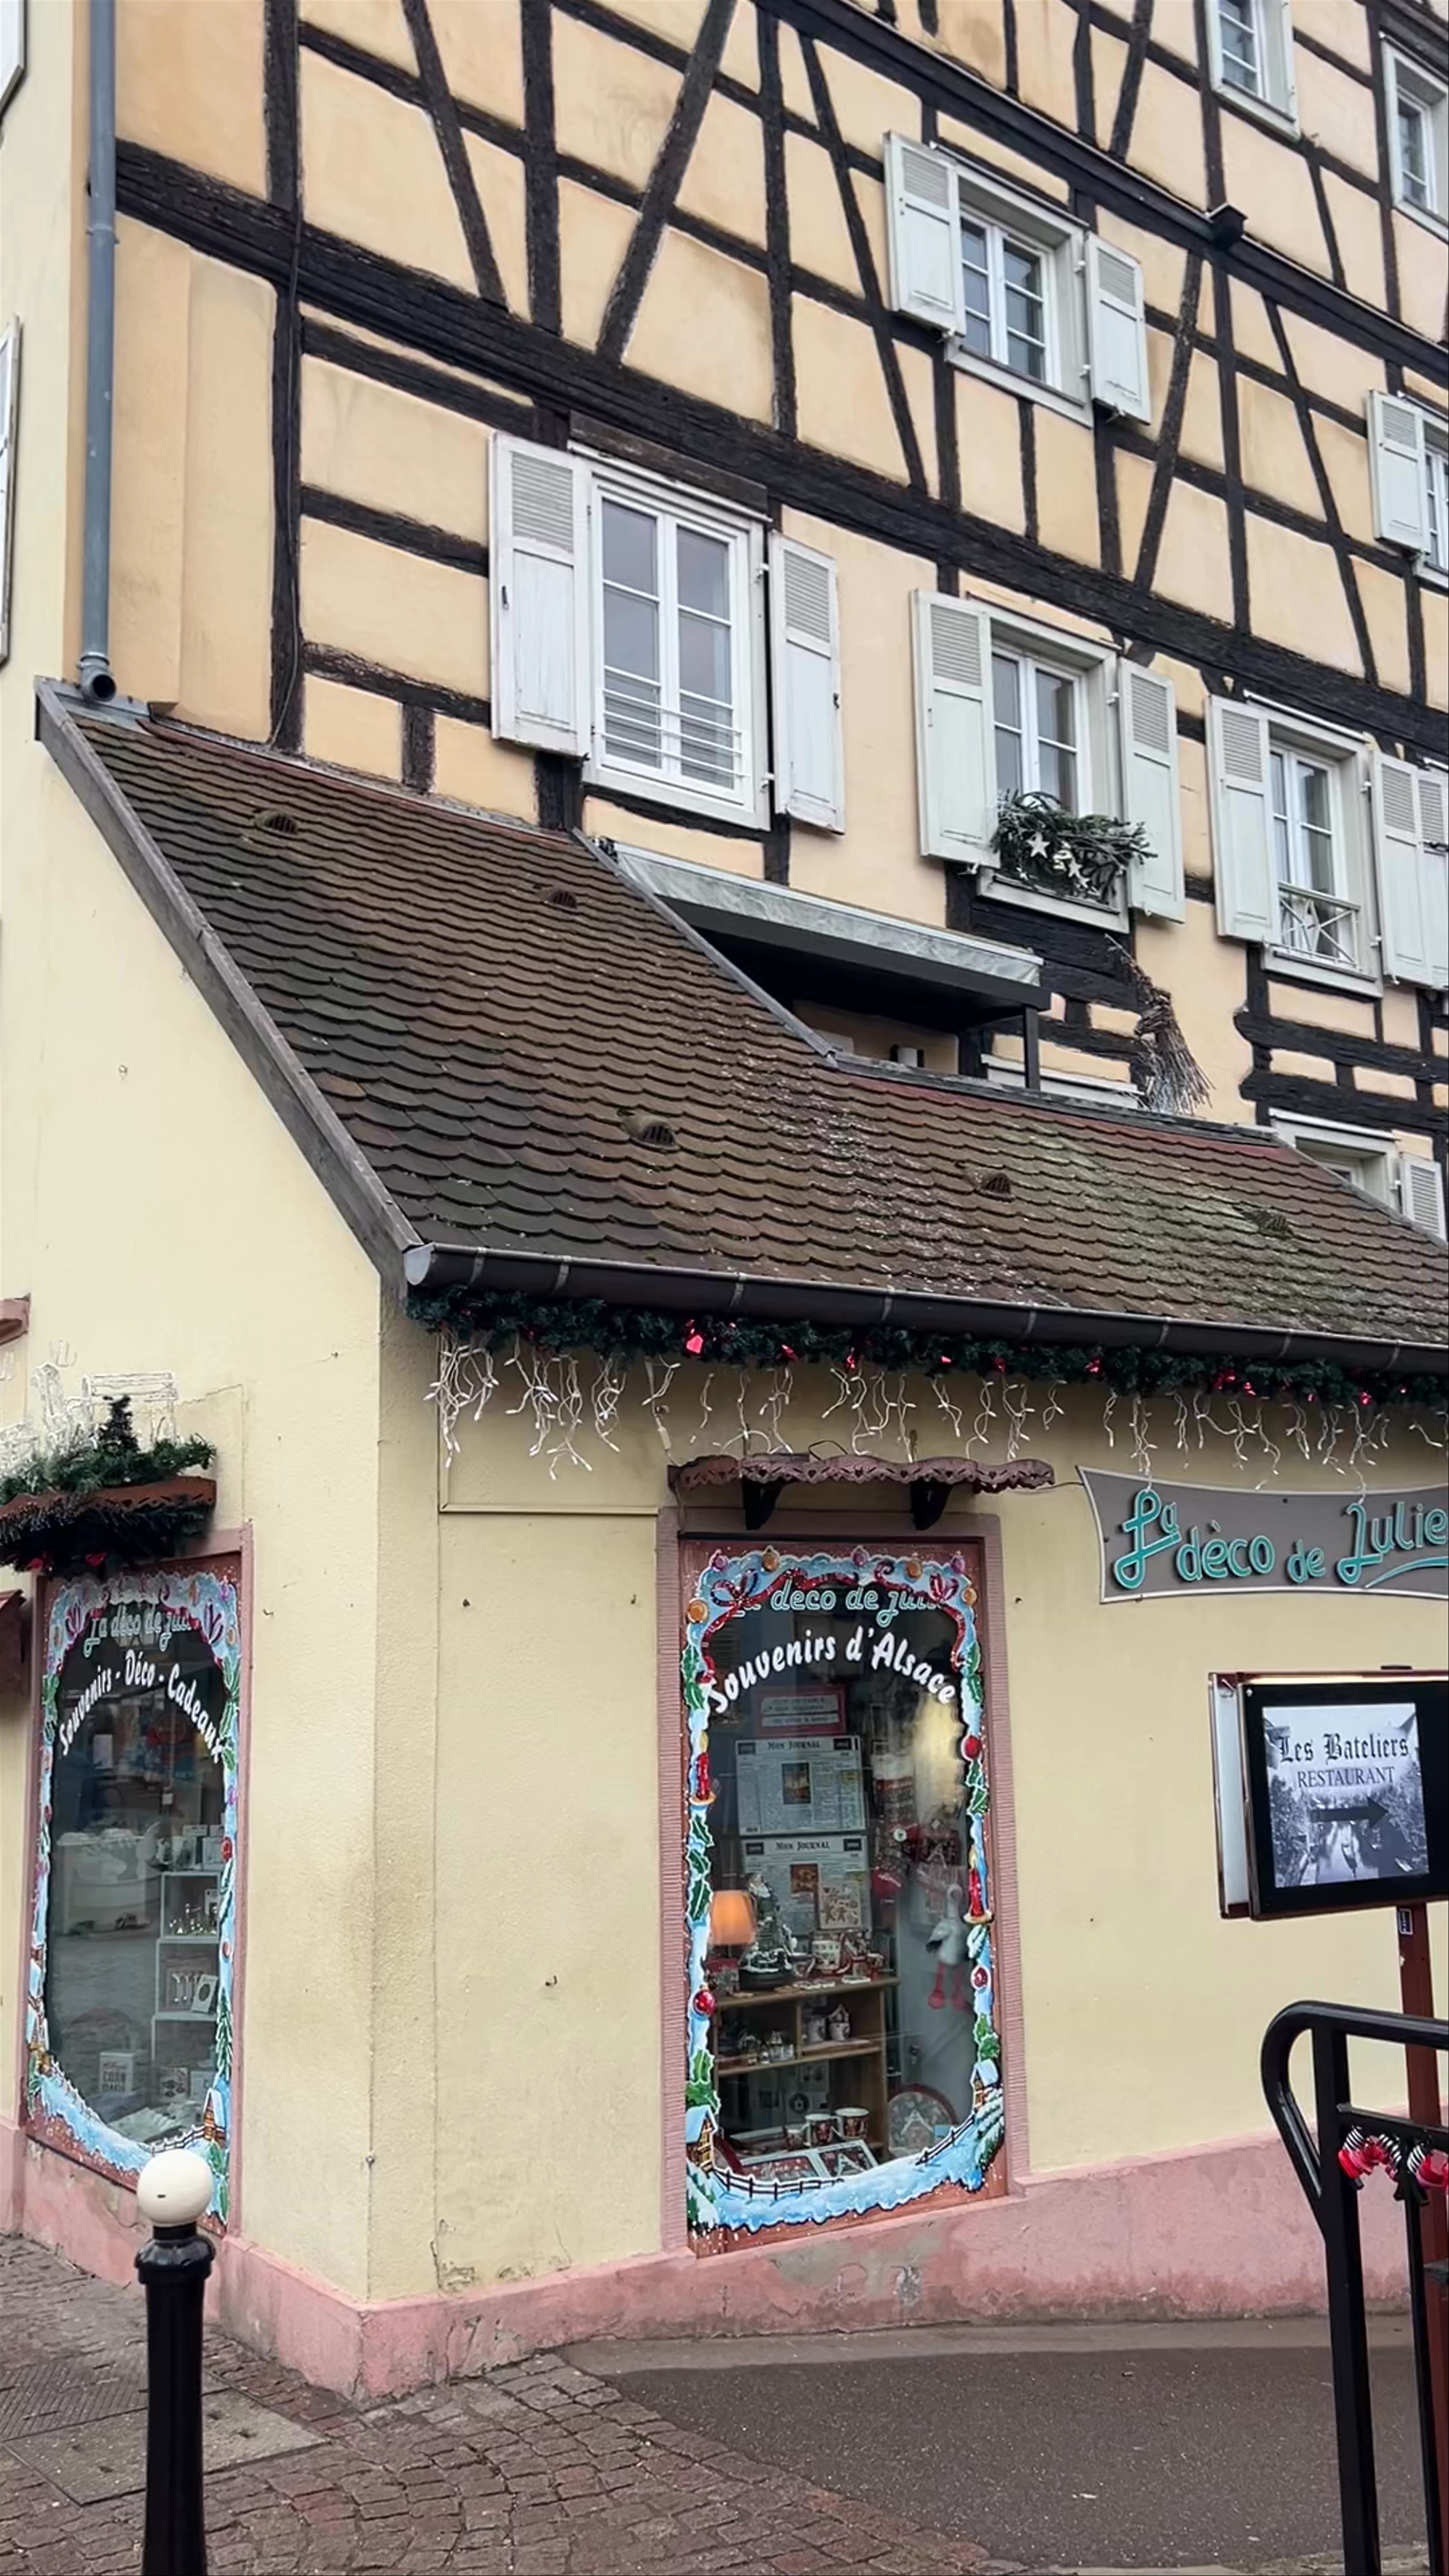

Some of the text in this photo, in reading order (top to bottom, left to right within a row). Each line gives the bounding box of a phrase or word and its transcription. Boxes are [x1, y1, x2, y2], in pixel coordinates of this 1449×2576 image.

[1114, 1489, 1181, 1589] La
[1287, 1539, 1327, 1583] de
[845, 1583, 880, 1610] de
[707, 1626, 956, 1714] Souvenirs d'Alsace
[59, 1649, 223, 1764] Souvenirs Déco Cadeaux
[1277, 1733, 1409, 1765] Les Bateliers
[1297, 1766, 1395, 1788] RESTAURANT
